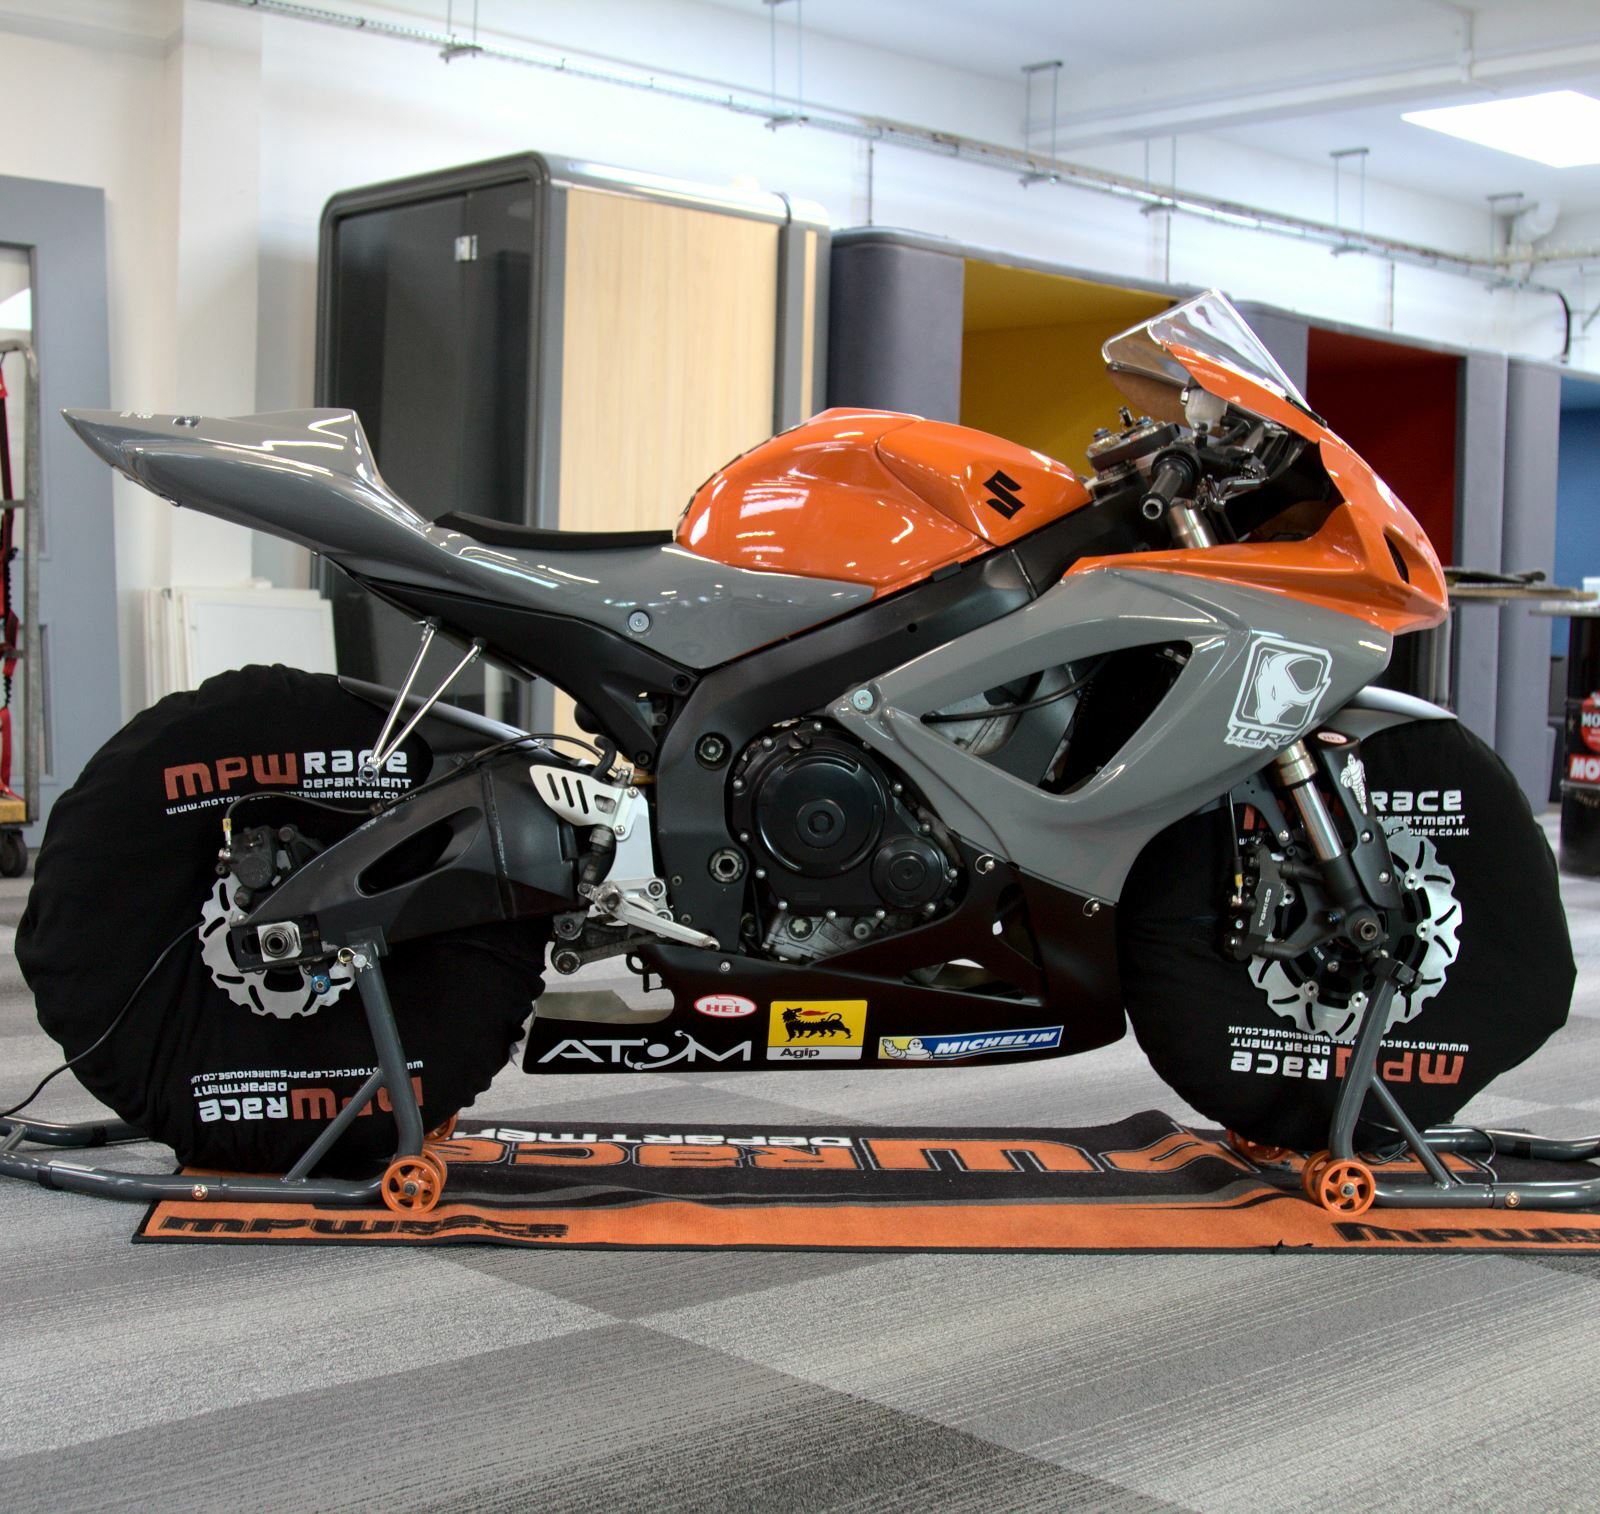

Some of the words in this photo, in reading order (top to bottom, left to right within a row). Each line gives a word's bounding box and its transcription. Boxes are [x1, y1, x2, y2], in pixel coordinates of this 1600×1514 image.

[706, 1003, 745, 1014] HEL
[537, 1030, 752, 1071] ATOM
[934, 1032, 1057, 1055] MICHELIN
[1231, 1038, 1331, 1055] DEPARTMENT
[780, 1047, 820, 1060] Agip
[193, 1082, 288, 1097] DEPARTMENT
